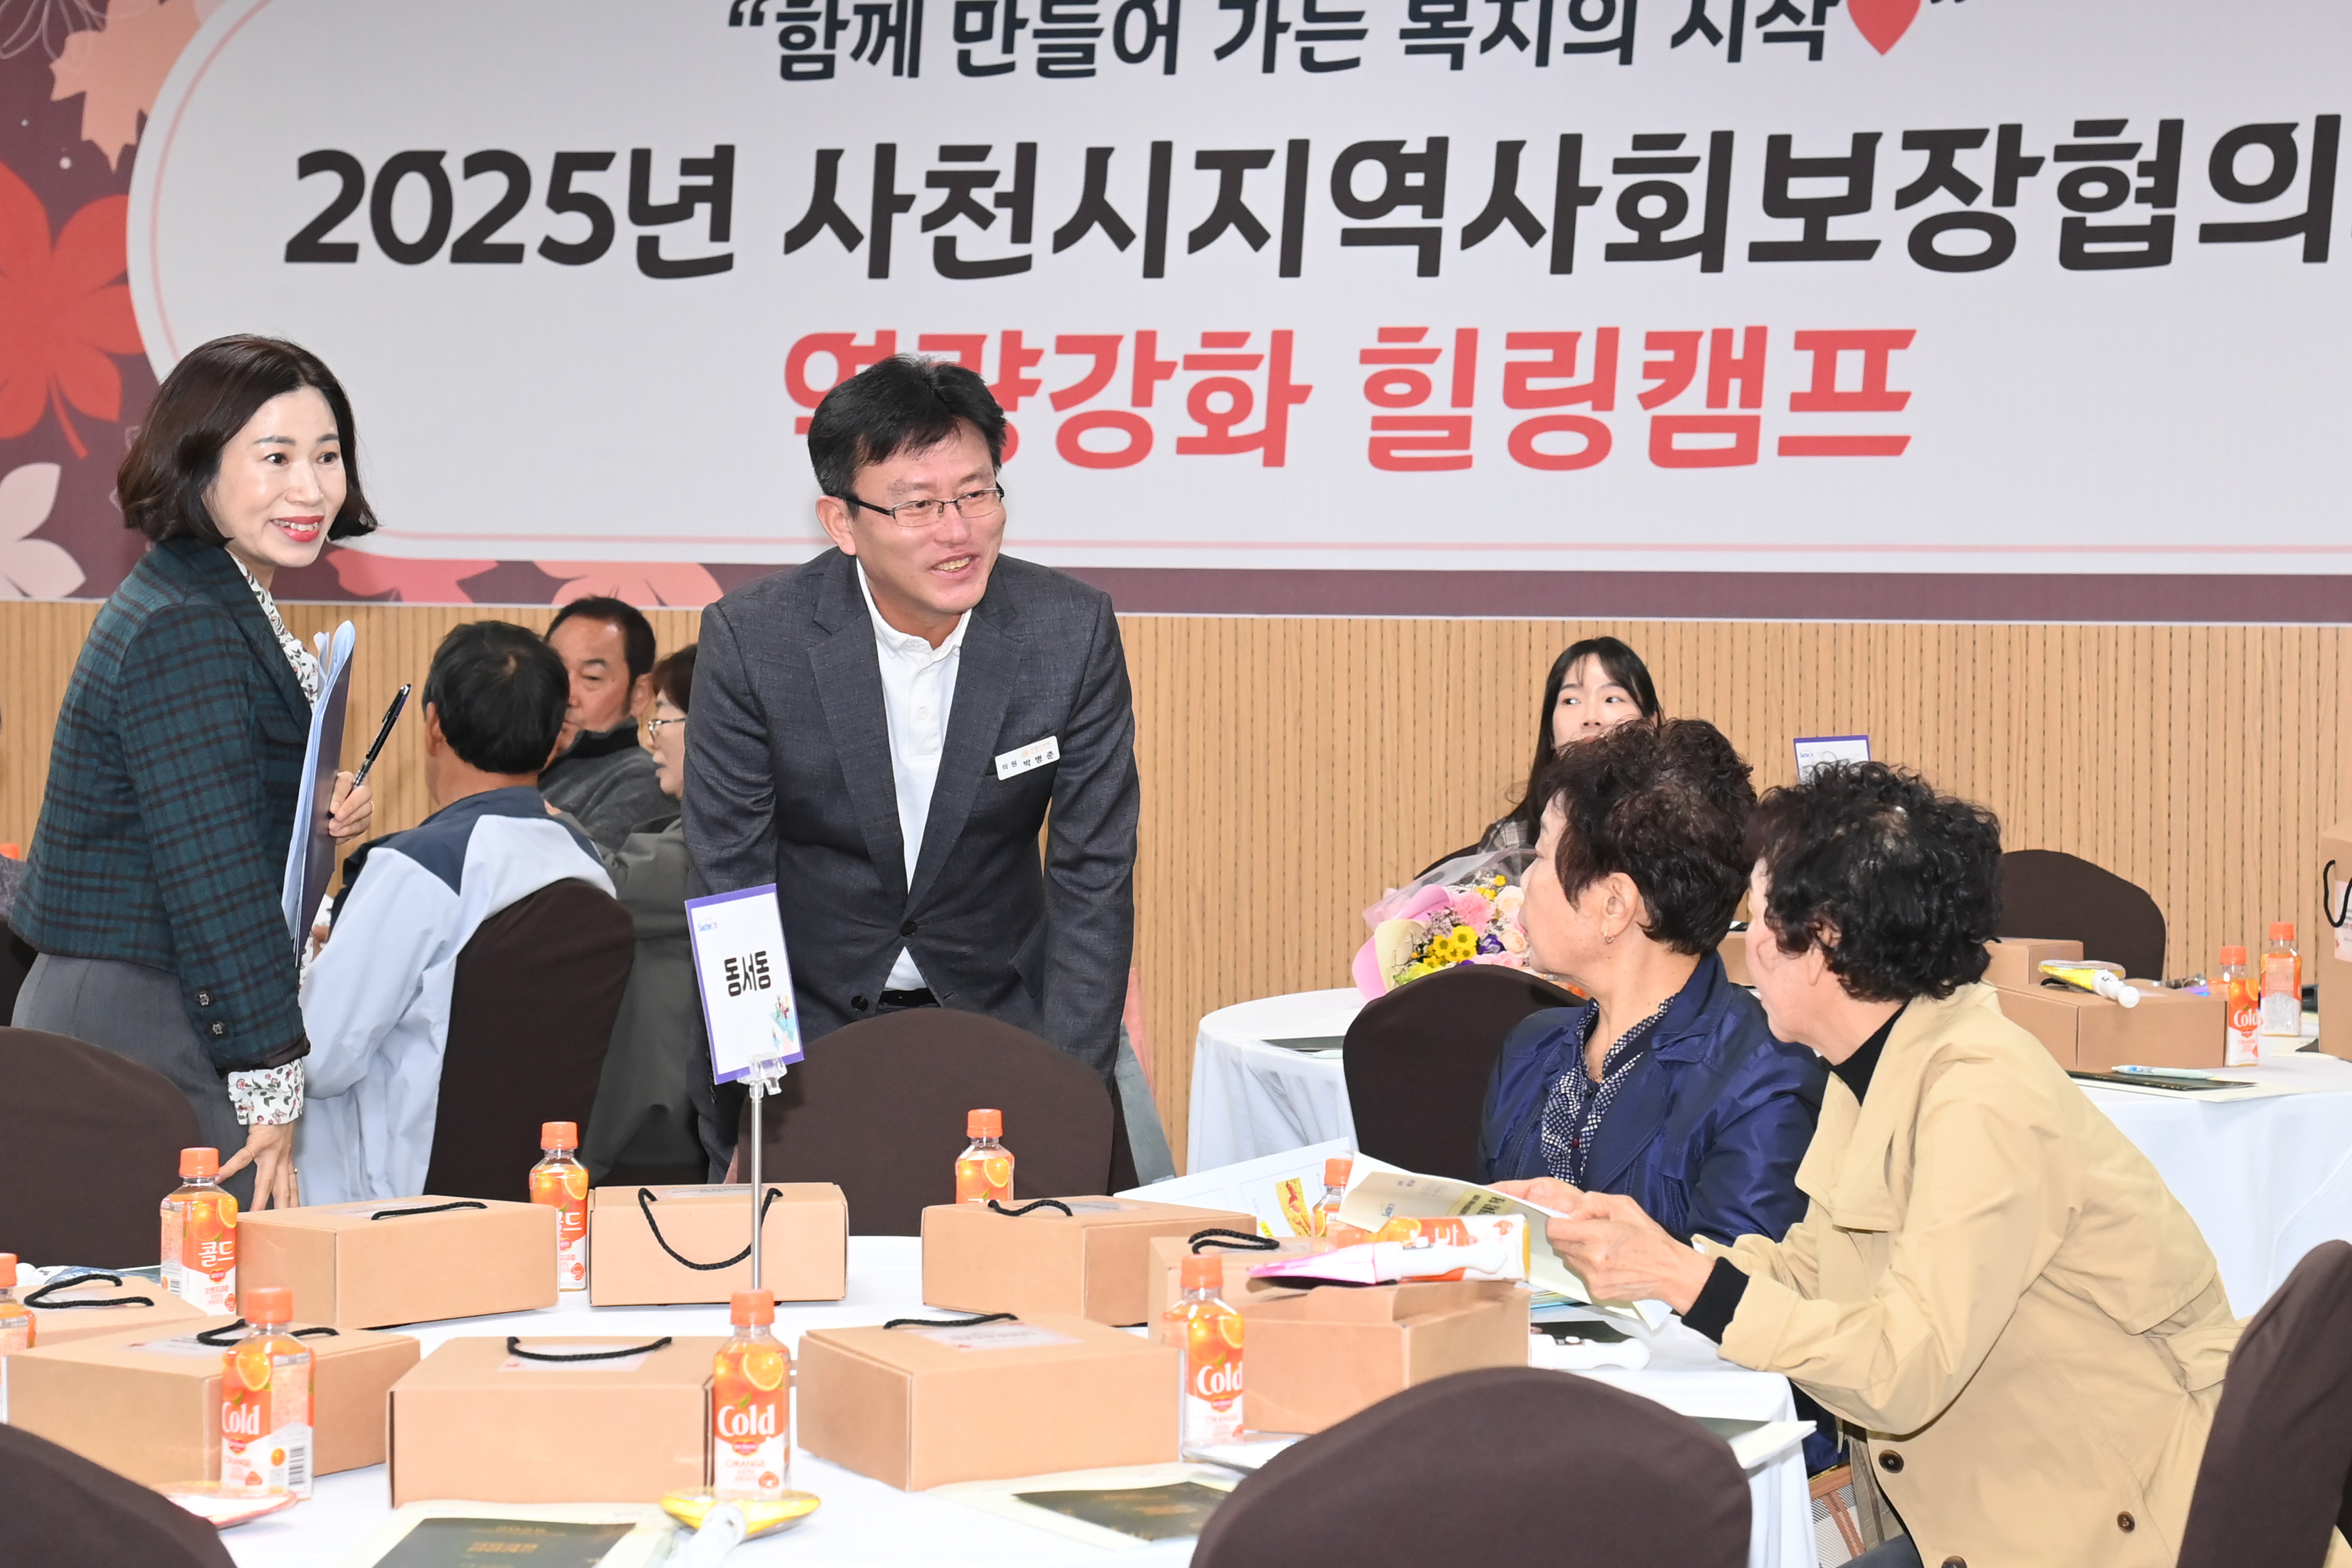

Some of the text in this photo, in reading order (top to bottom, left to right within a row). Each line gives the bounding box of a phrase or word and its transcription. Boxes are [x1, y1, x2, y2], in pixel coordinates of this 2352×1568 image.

[952, 0, 1181, 78] 만들어
[1213, 0, 1369, 74] 가는
[1398, 0, 1637, 71] 복지의
[1670, 0, 1839, 63] 시작
[284, 114, 2352, 280] 2025년 사천시지역사회보장협의
[1359, 325, 1917, 472] 힐링캠프
[1002, 751, 1054, 770] 의원 박병준
[724, 950, 771, 997] 동서동
[198, 1241, 234, 1267] 콜드
[1197, 1361, 1243, 1396] Cold
[222, 1401, 260, 1435] Cold
[717, 1404, 775, 1437] Cold
